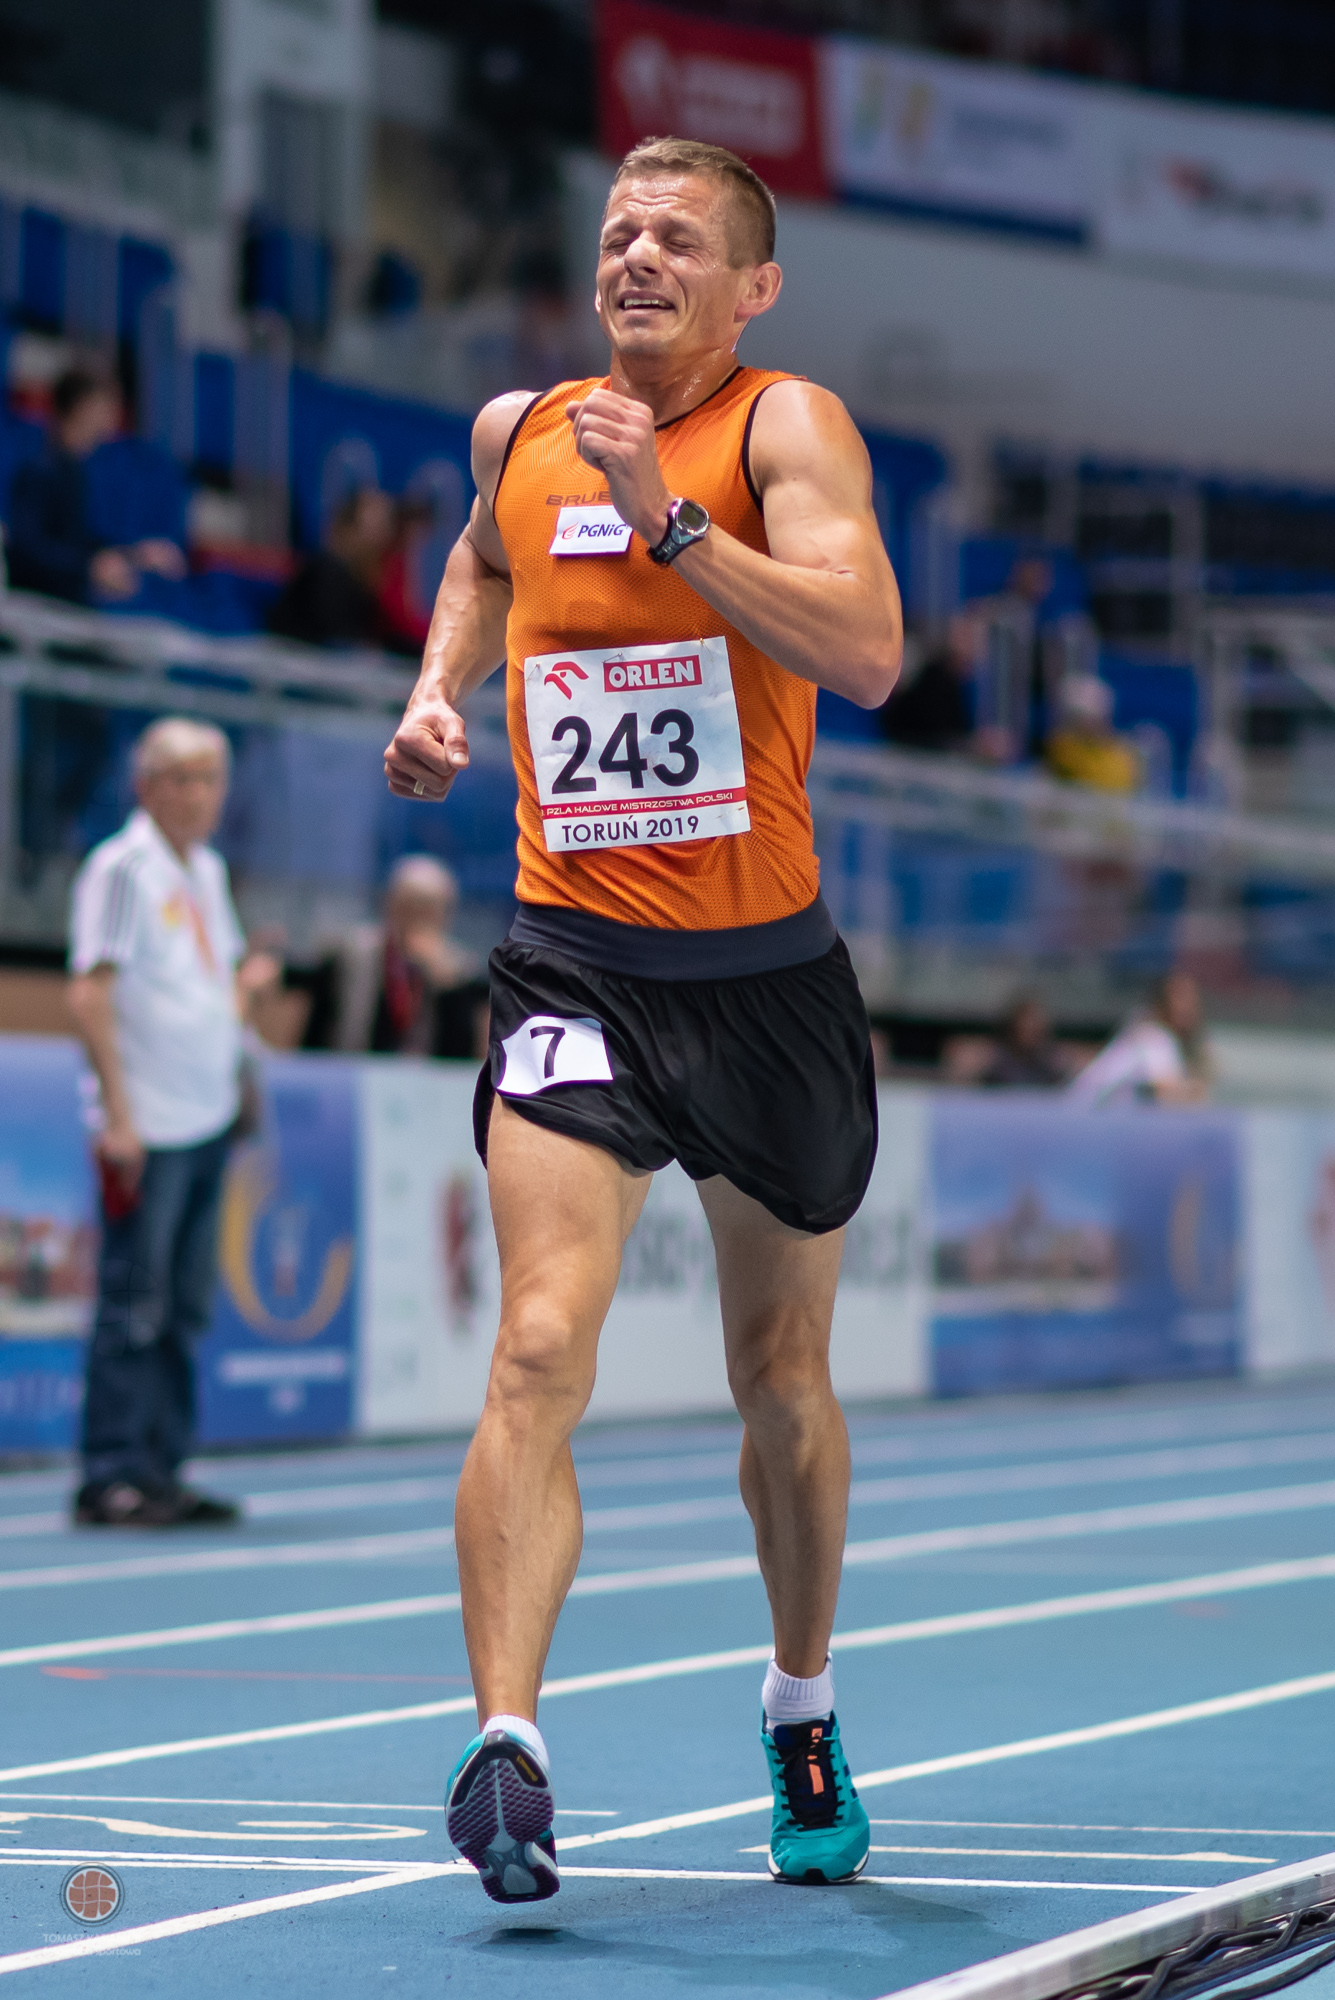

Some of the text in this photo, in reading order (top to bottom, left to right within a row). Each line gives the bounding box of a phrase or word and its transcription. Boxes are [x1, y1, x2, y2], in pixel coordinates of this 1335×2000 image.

[577, 523, 627, 538] PGNiG
[608, 659, 696, 688] ORLEN
[551, 708, 700, 794] 243
[546, 807, 572, 816] PZLA
[574, 803, 618, 814] HALOWE
[620, 798, 695, 811] MISTRZOSTWA
[695, 792, 733, 805] POLSKI
[561, 815, 699, 844] TORUŃ 2019
[529, 1025, 566, 1079] 7
